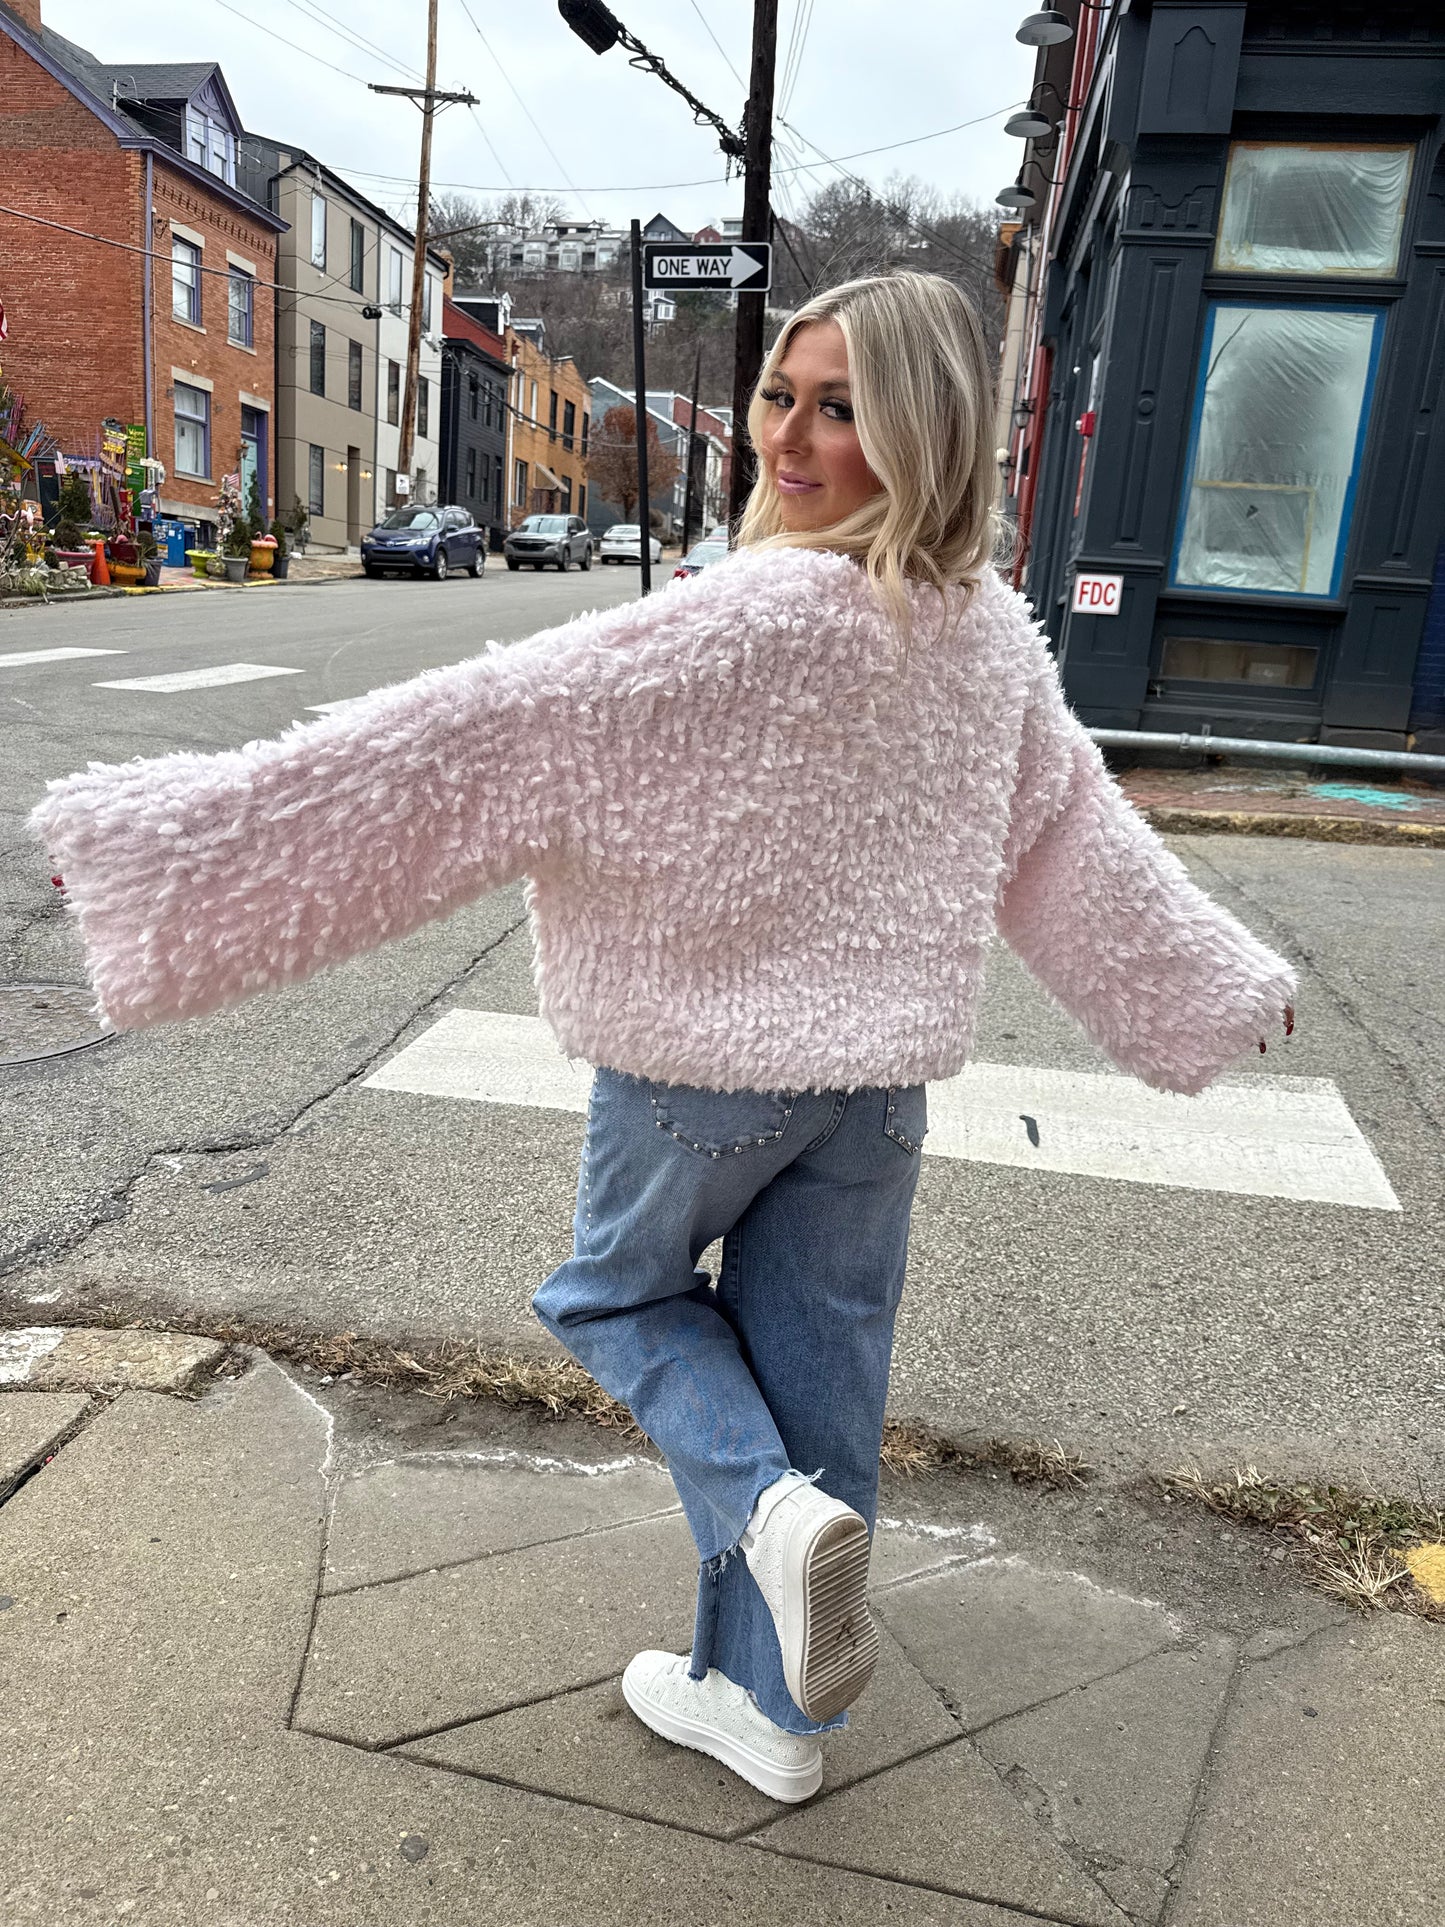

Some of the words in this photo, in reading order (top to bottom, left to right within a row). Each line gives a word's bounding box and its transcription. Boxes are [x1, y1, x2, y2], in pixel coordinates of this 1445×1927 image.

[657, 258, 690, 275] ONE
[696, 258, 732, 275] WAY
[1078, 581, 1116, 606] FDC
